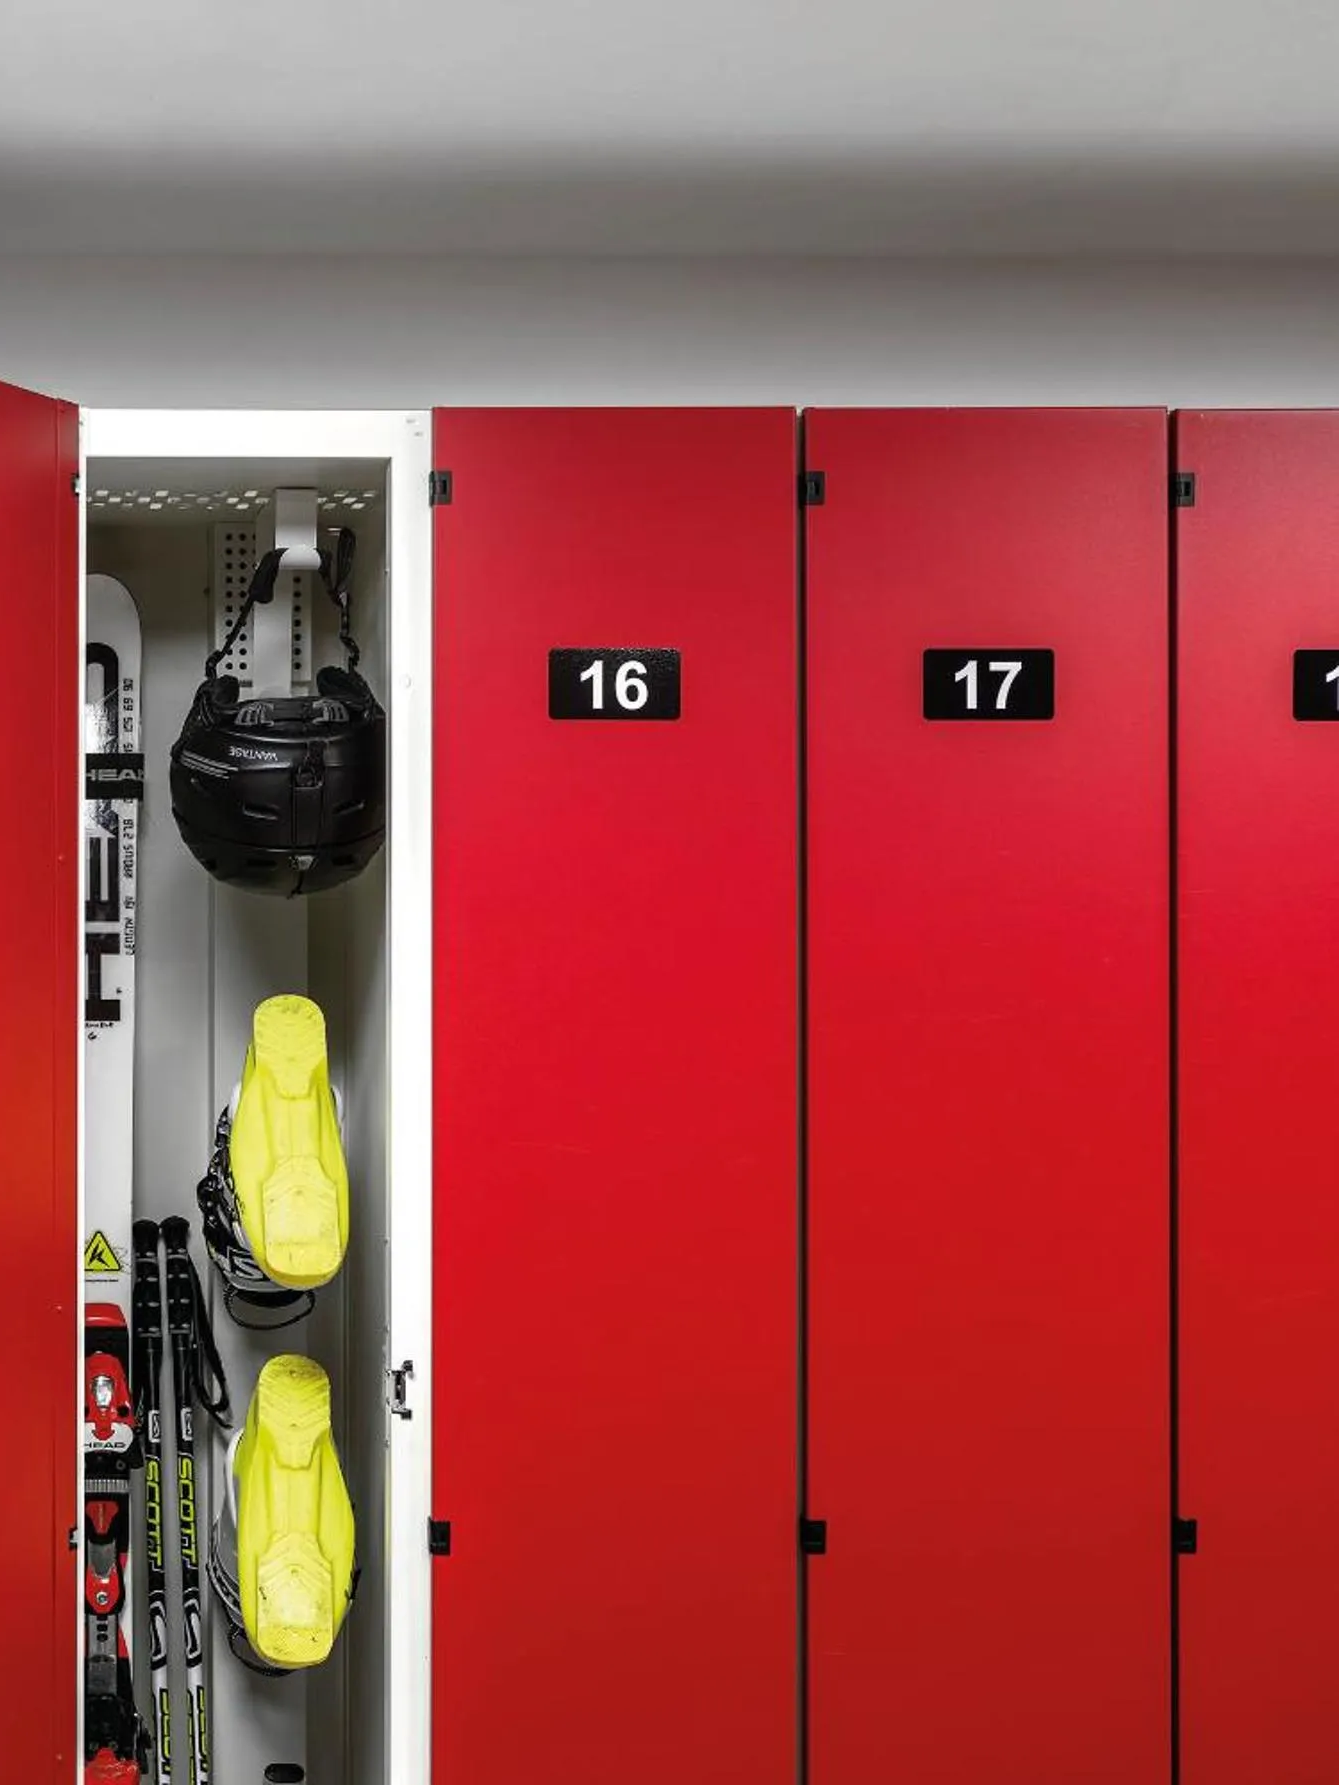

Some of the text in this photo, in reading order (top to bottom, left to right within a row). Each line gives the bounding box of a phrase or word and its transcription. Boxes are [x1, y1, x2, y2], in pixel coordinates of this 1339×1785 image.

[579, 659, 649, 710] 16
[954, 660, 1023, 710] 17
[86, 768, 144, 781] HEA
[145, 1460, 162, 1567] SCOTT
[177, 1456, 197, 1565] SCOTT
